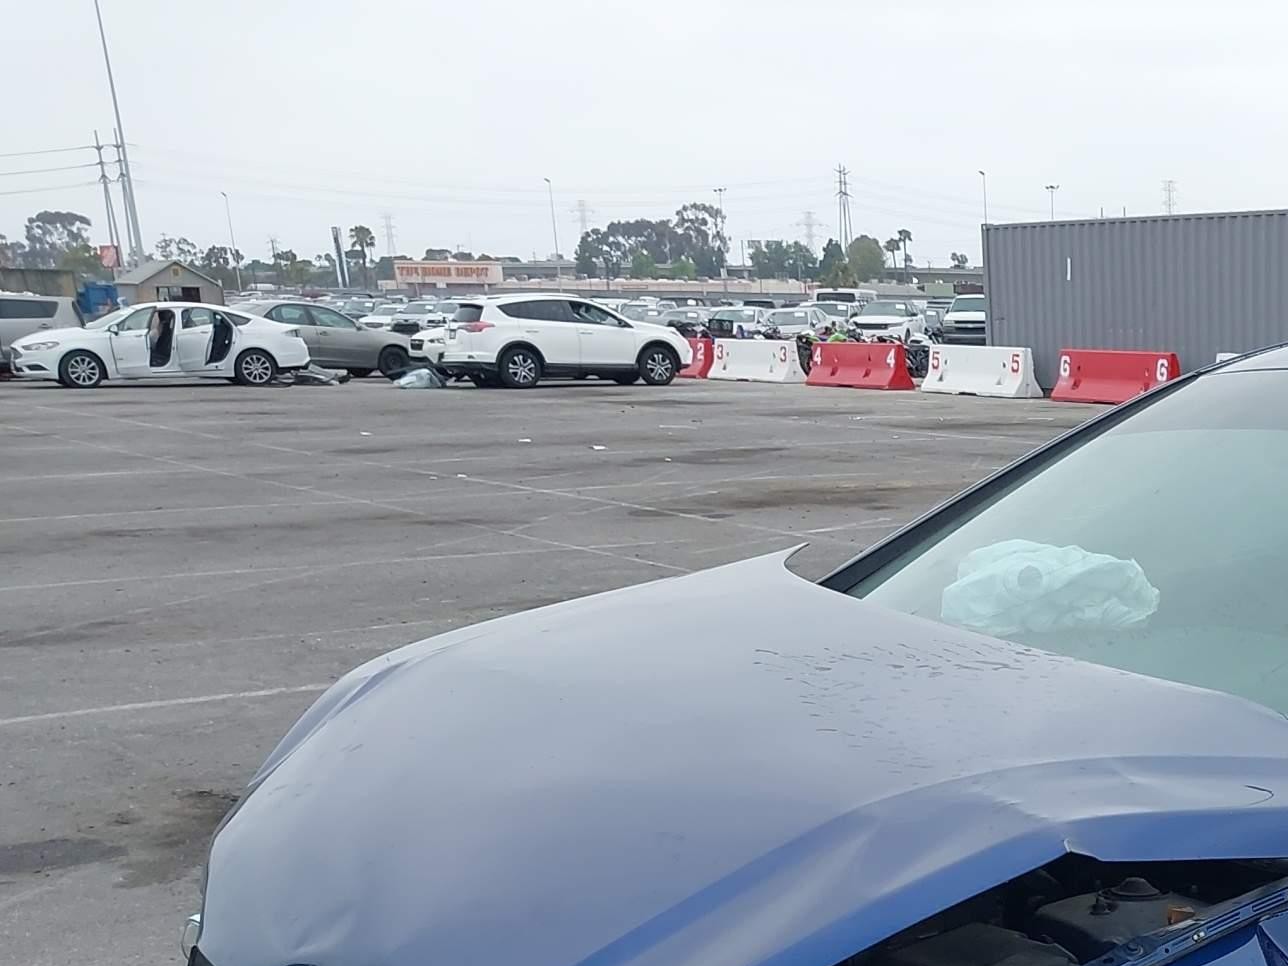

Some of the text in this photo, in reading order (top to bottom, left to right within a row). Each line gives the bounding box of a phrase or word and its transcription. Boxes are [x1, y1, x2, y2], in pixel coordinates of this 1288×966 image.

[696, 342, 705, 361] 2
[716, 343, 787, 363] 3 3
[812, 346, 896, 368] 4 4
[931, 351, 1020, 373] 5 5
